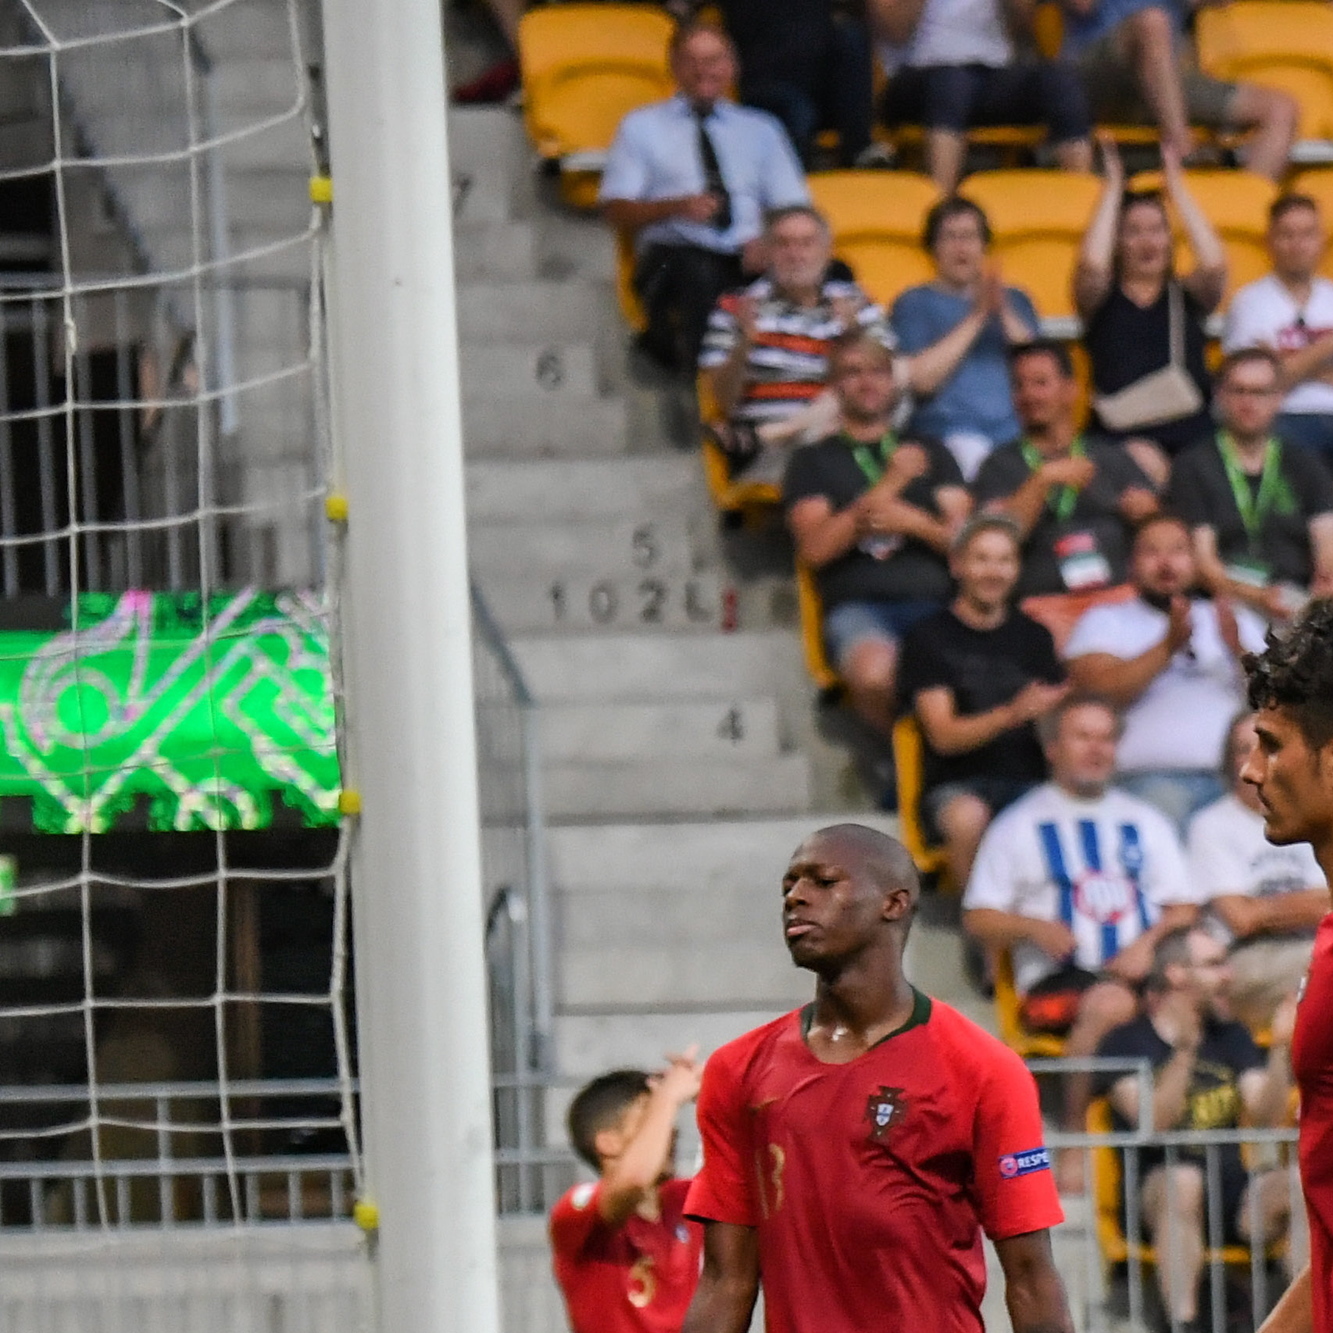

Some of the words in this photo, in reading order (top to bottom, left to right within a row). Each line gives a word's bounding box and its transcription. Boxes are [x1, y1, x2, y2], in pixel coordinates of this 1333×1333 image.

[535, 350, 562, 391] 6
[631, 523, 661, 569] 5
[717, 706, 745, 742] 4
